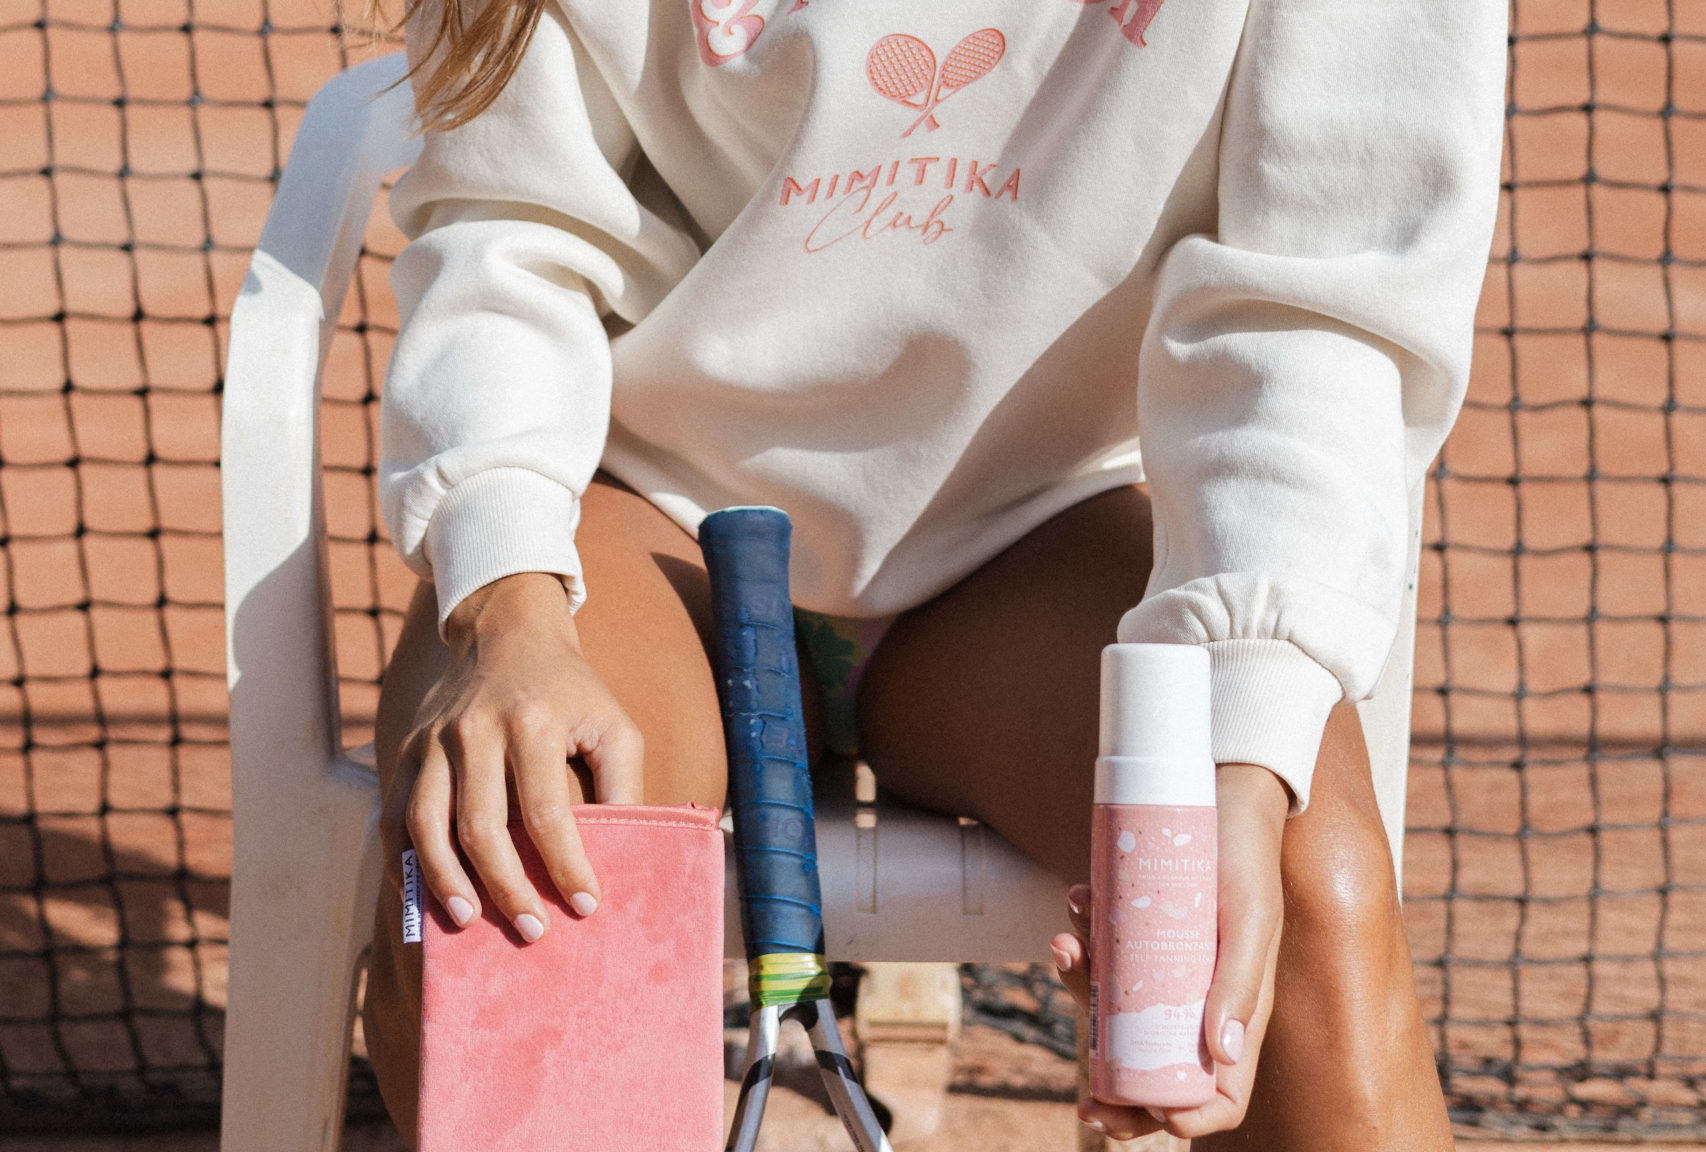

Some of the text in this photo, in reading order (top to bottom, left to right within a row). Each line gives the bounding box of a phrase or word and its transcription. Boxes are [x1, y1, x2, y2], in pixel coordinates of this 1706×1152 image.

[778, 155, 1022, 208] MIMITIKA
[804, 190, 954, 254] Club
[1138, 857, 1212, 873] MIMITIKA
[404, 855, 416, 938] MIMITIKA
[1156, 928, 1201, 939] MOUSSE
